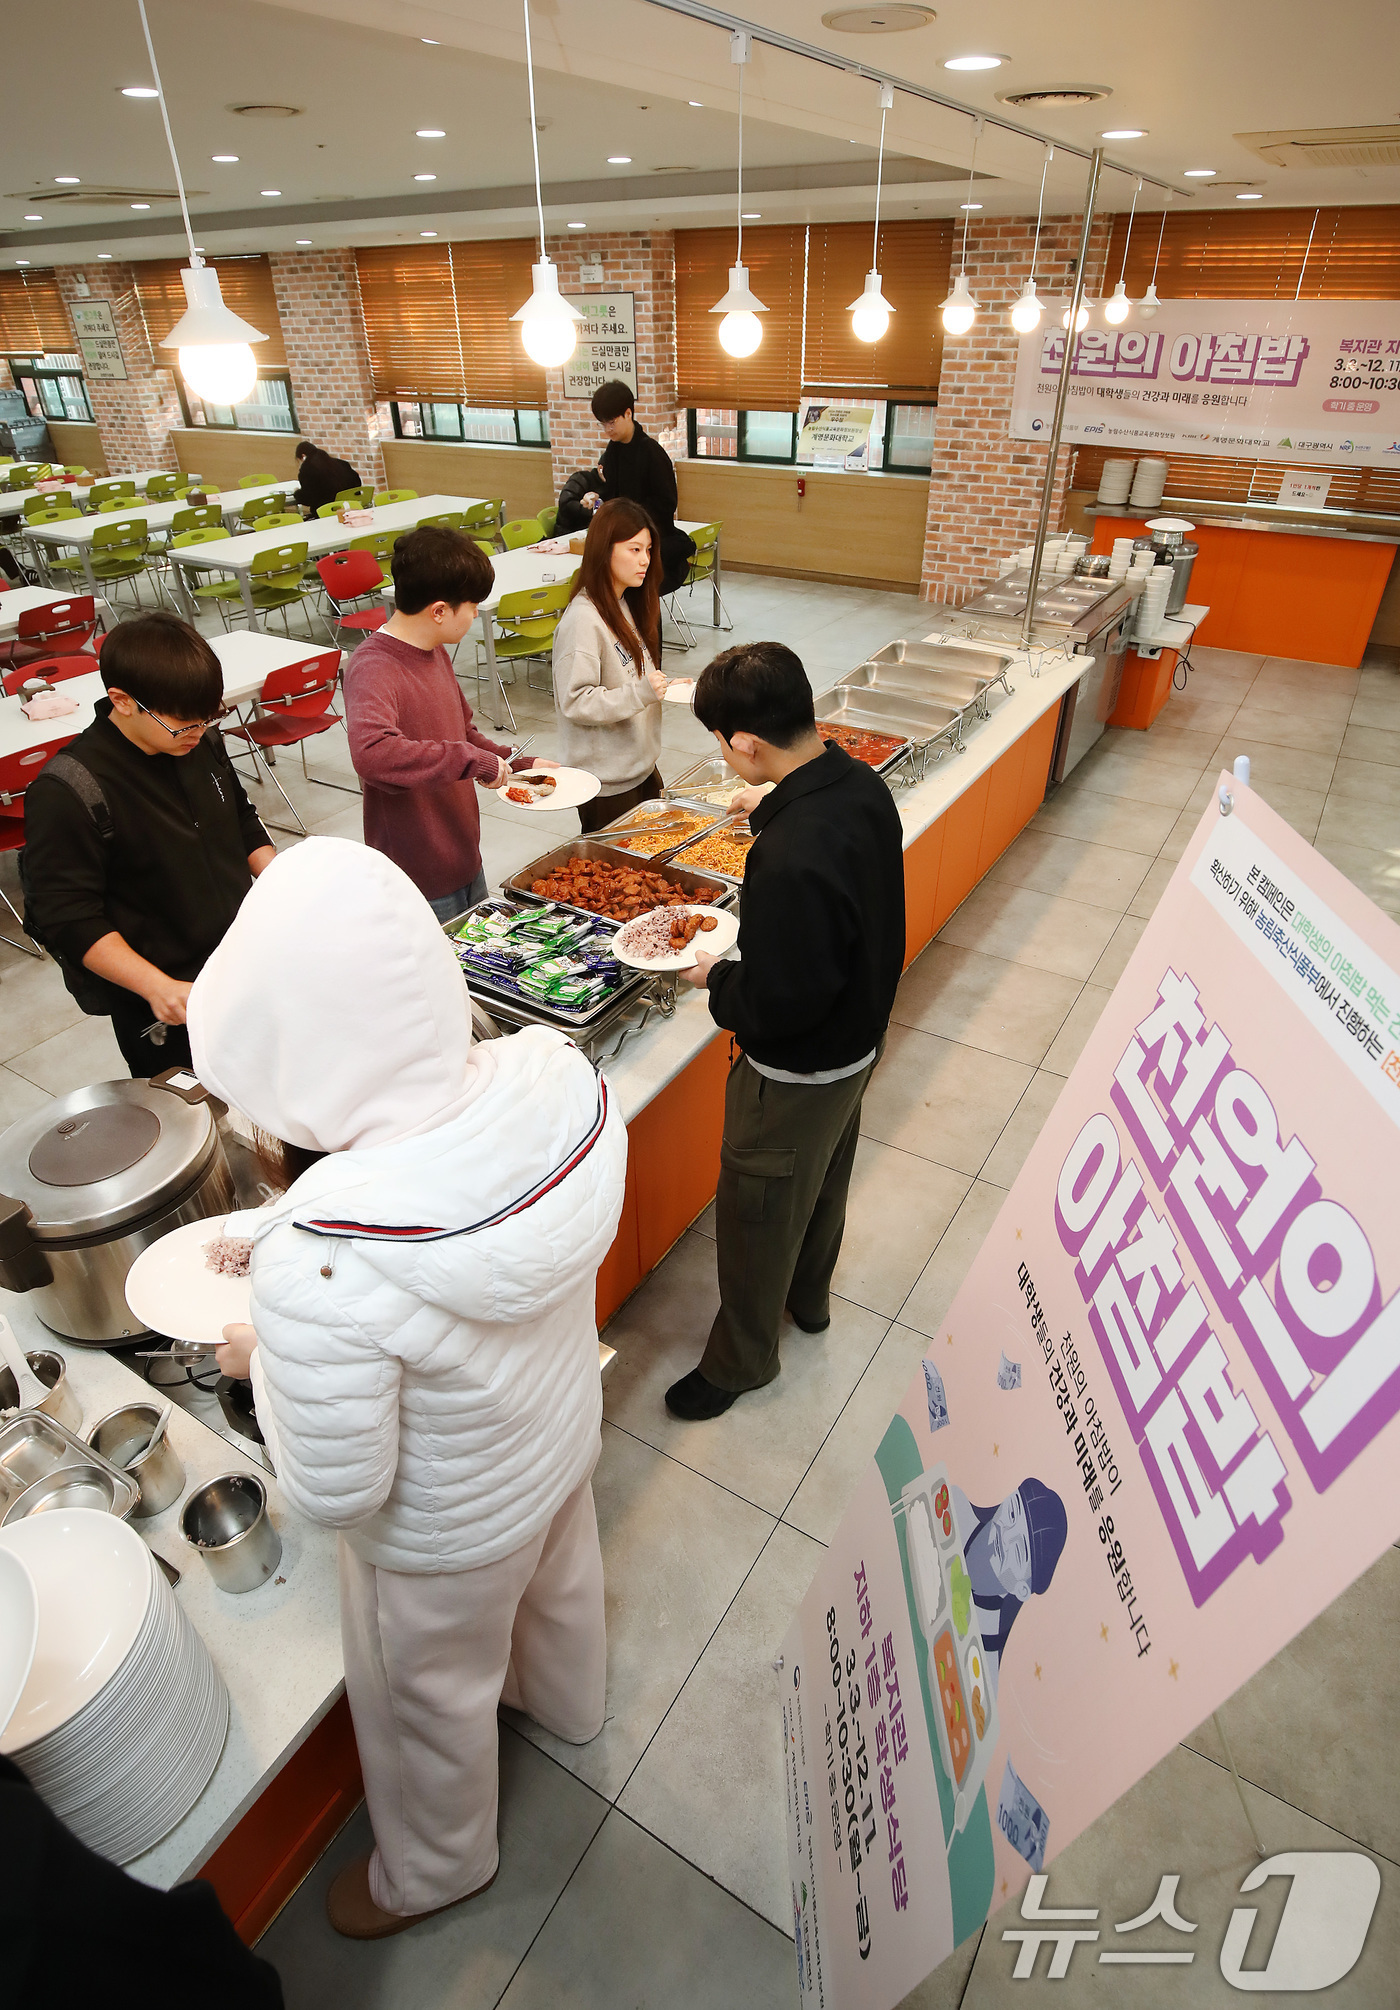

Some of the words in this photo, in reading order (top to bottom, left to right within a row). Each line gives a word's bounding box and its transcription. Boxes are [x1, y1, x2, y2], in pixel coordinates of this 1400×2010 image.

[581, 304, 616, 317] 빈그릇은
[601, 323, 628, 335] 주세요.
[591, 345, 630, 357] 드실만큼만
[591, 360, 607, 372] 덜어
[609, 360, 632, 373] 드시길
[1040, 325, 1164, 379] 천원의
[1169, 331, 1311, 388] 아침밥
[1339, 338, 1383, 354] 복지관
[1097, 387, 1140, 400] 대학생들의
[1142, 390, 1170, 403] 건강과
[1172, 391, 1199, 404] 미래를
[1201, 394, 1248, 406] 응원합니다
[1084, 423, 1106, 434] EPIS
[1298, 440, 1334, 450] 대구광역시
[1209, 858, 1243, 902] 확산하기
[1238, 891, 1260, 921] 위해
[1254, 908, 1342, 1011] 농림축산식품부에서
[1335, 999, 1385, 1062] 진행하는
[1246, 863, 1262, 887] 본
[1256, 873, 1296, 922] 캠페인은
[1291, 911, 1335, 964] 대학생의
[1331, 952, 1368, 999] 아침밥
[1365, 986, 1391, 1025] 먹는
[1110, 966, 1400, 1495] 천원의
[1053, 1112, 1293, 1609] 아침밥
[1060, 1329, 1088, 1399] 천원의
[1084, 1397, 1123, 1496] 아침밥이
[1017, 1261, 1055, 1365] 대학생들의
[1049, 1358, 1079, 1435] 건강과
[1074, 1431, 1105, 1514] 미래를
[1098, 1515, 1152, 1658] 응원합니다
[881, 1631, 909, 1767] 복지관
[853, 1559, 873, 1640] 지하
[864, 1641, 881, 1709] 1층
[875, 1714, 909, 1913] 학생식당
[998, 1802, 1019, 1846] 1000
